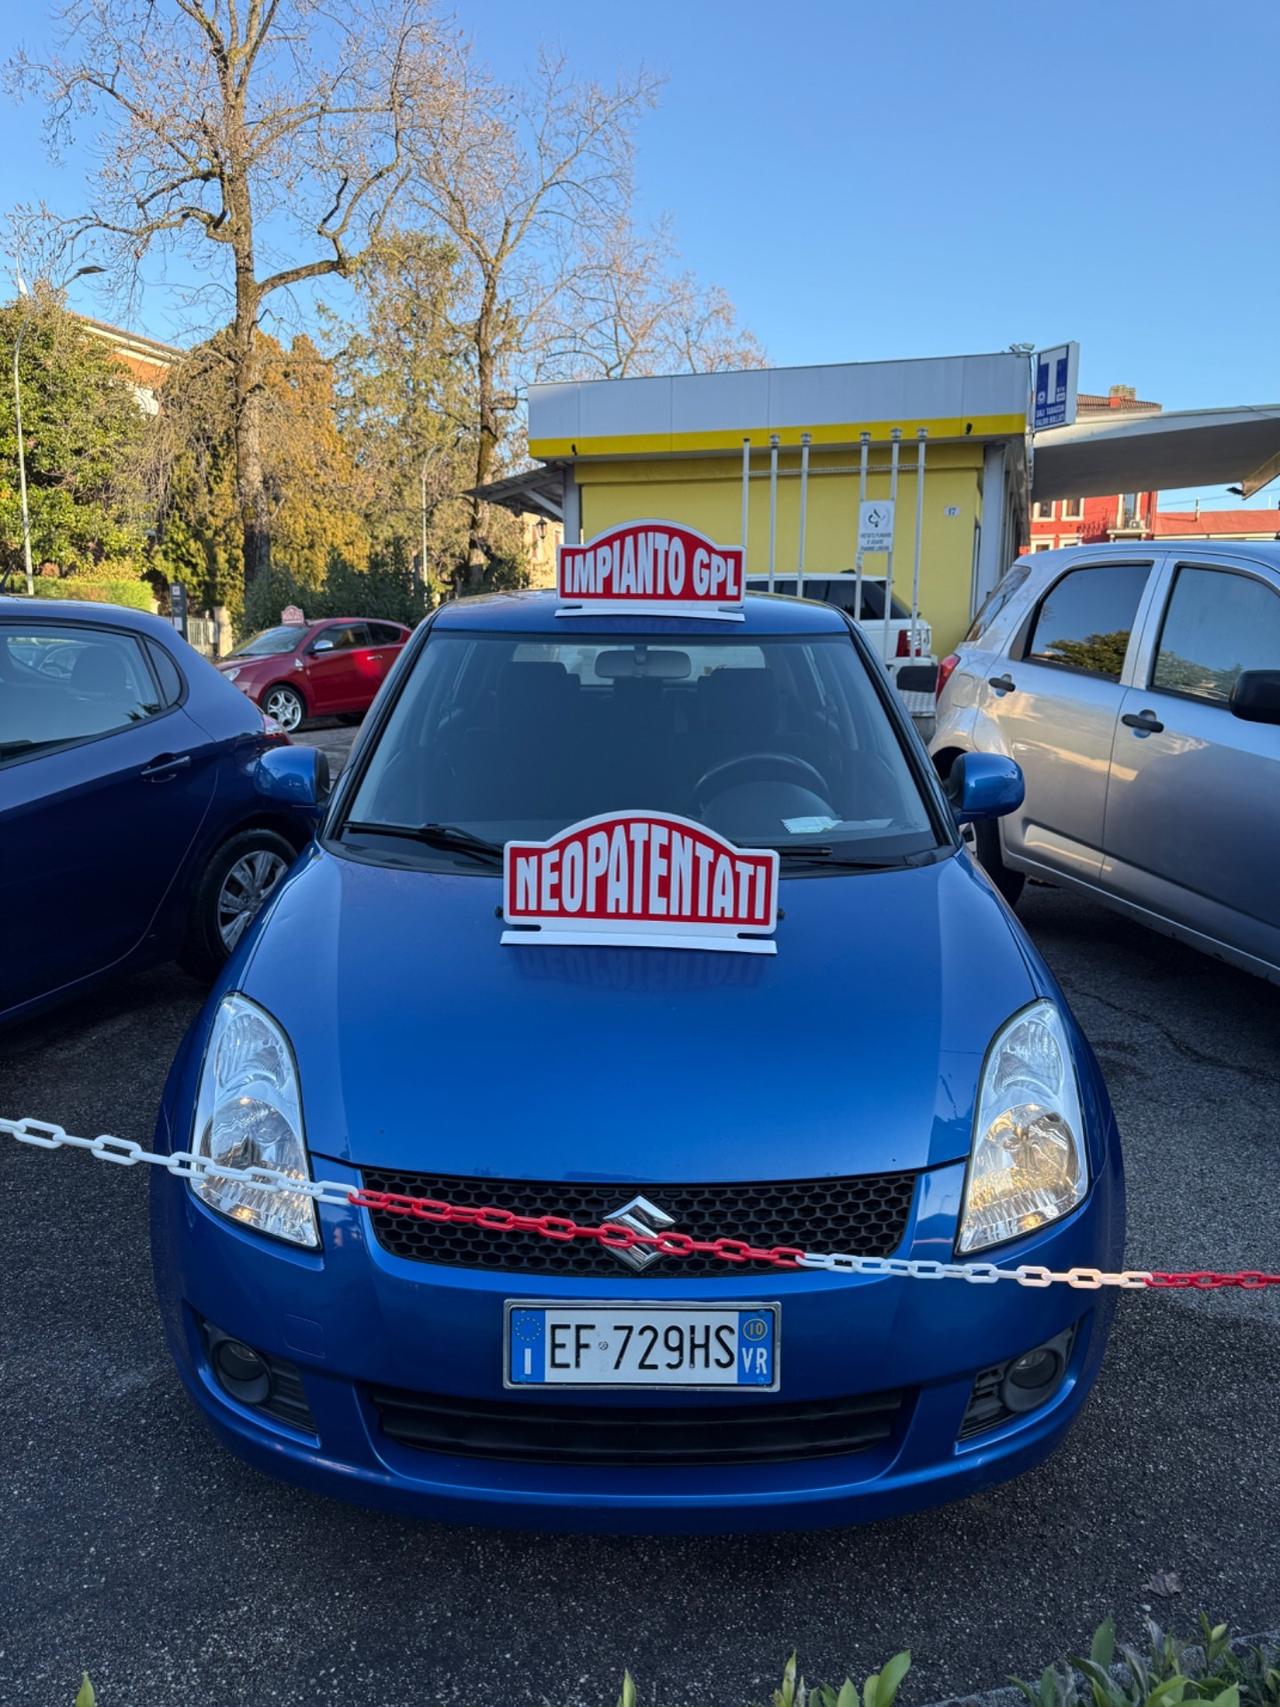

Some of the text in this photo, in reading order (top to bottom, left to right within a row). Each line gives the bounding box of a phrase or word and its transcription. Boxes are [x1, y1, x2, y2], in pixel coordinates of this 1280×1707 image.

[1040, 346, 1067, 404] T
[564, 531, 739, 596] IMPIANTO GPL
[516, 823, 767, 919] NEOPATENTATI
[524, 1324, 768, 1375] I EF 729HS VR
